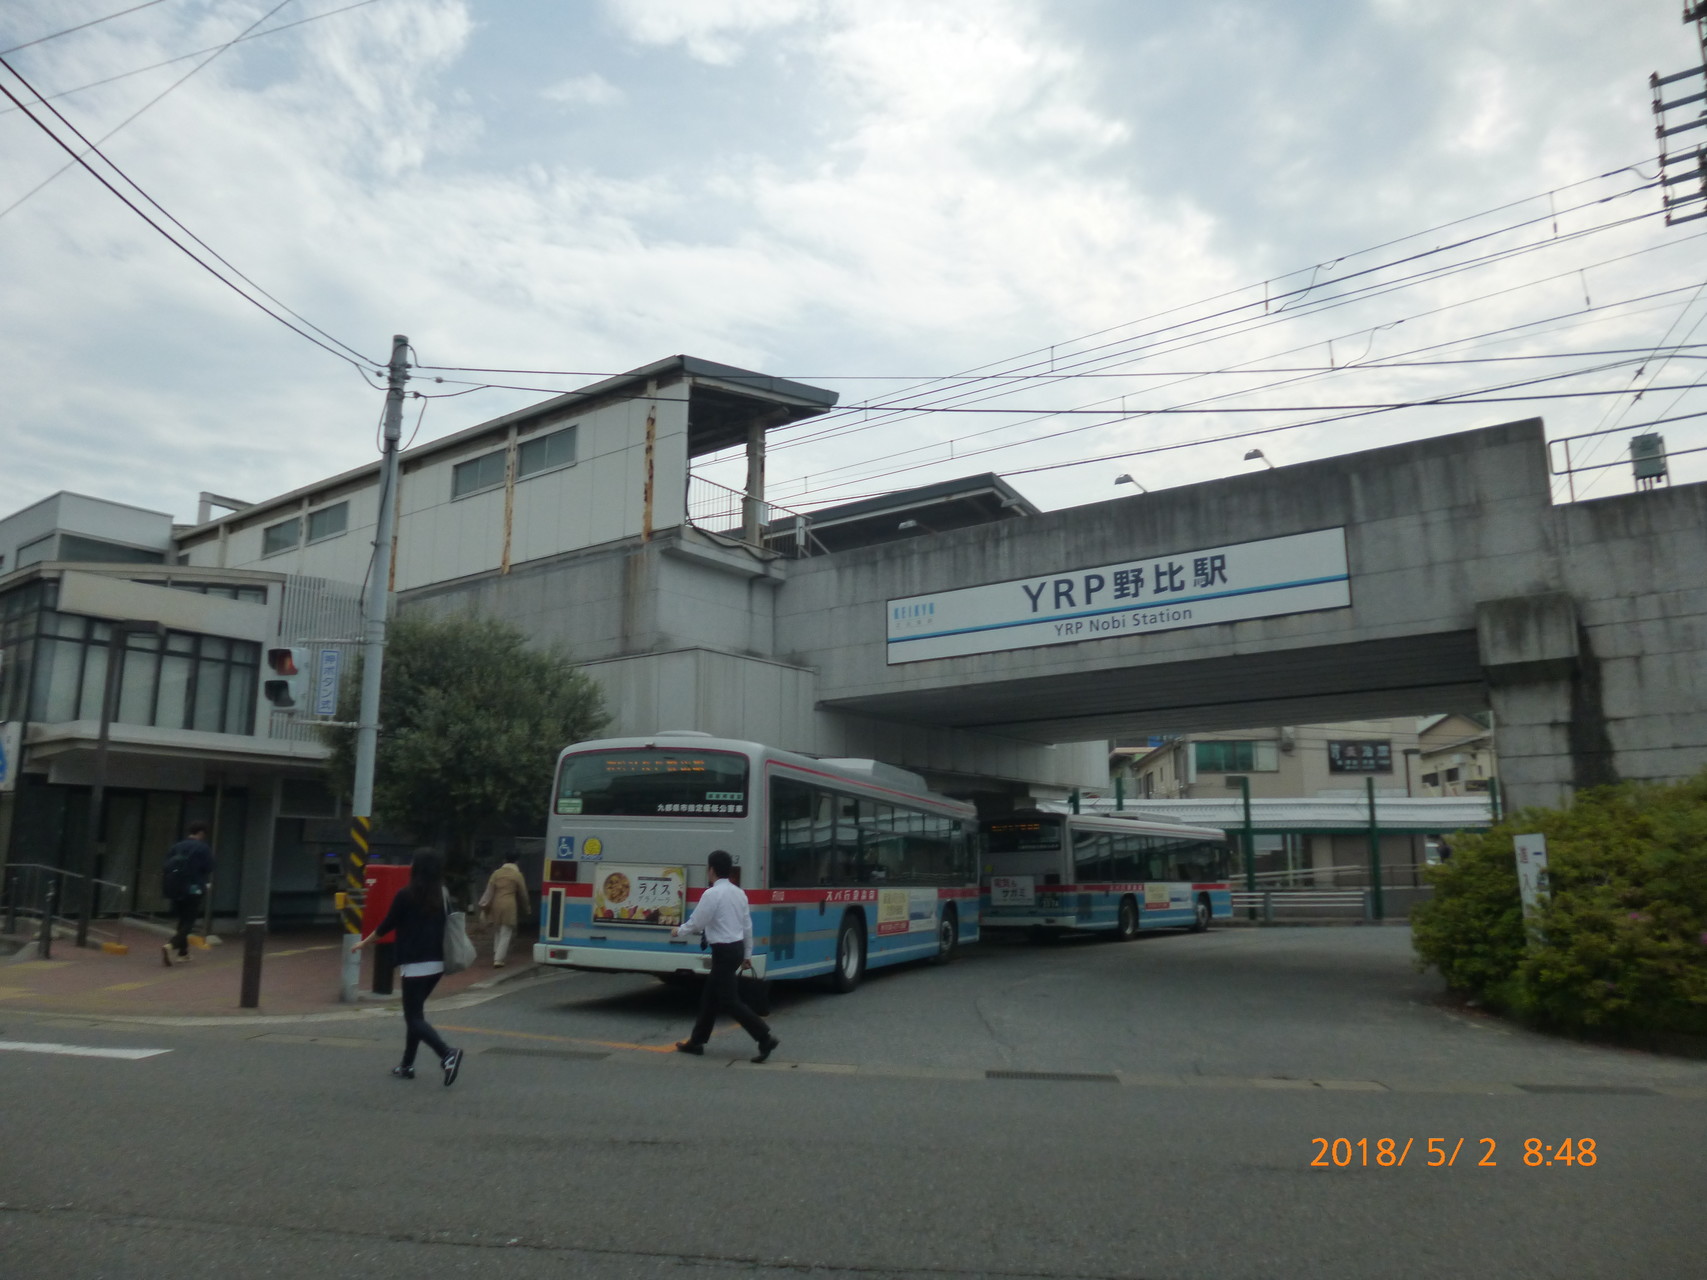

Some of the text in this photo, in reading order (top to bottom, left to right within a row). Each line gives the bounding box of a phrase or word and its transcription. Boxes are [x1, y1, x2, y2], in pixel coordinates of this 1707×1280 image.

[1021, 553, 1229, 613] YRP野比駅
[894, 602, 935, 620] KEIKYU
[1054, 606, 1193, 637] YRP Nobi Station
[639, 883, 671, 895] ライス
